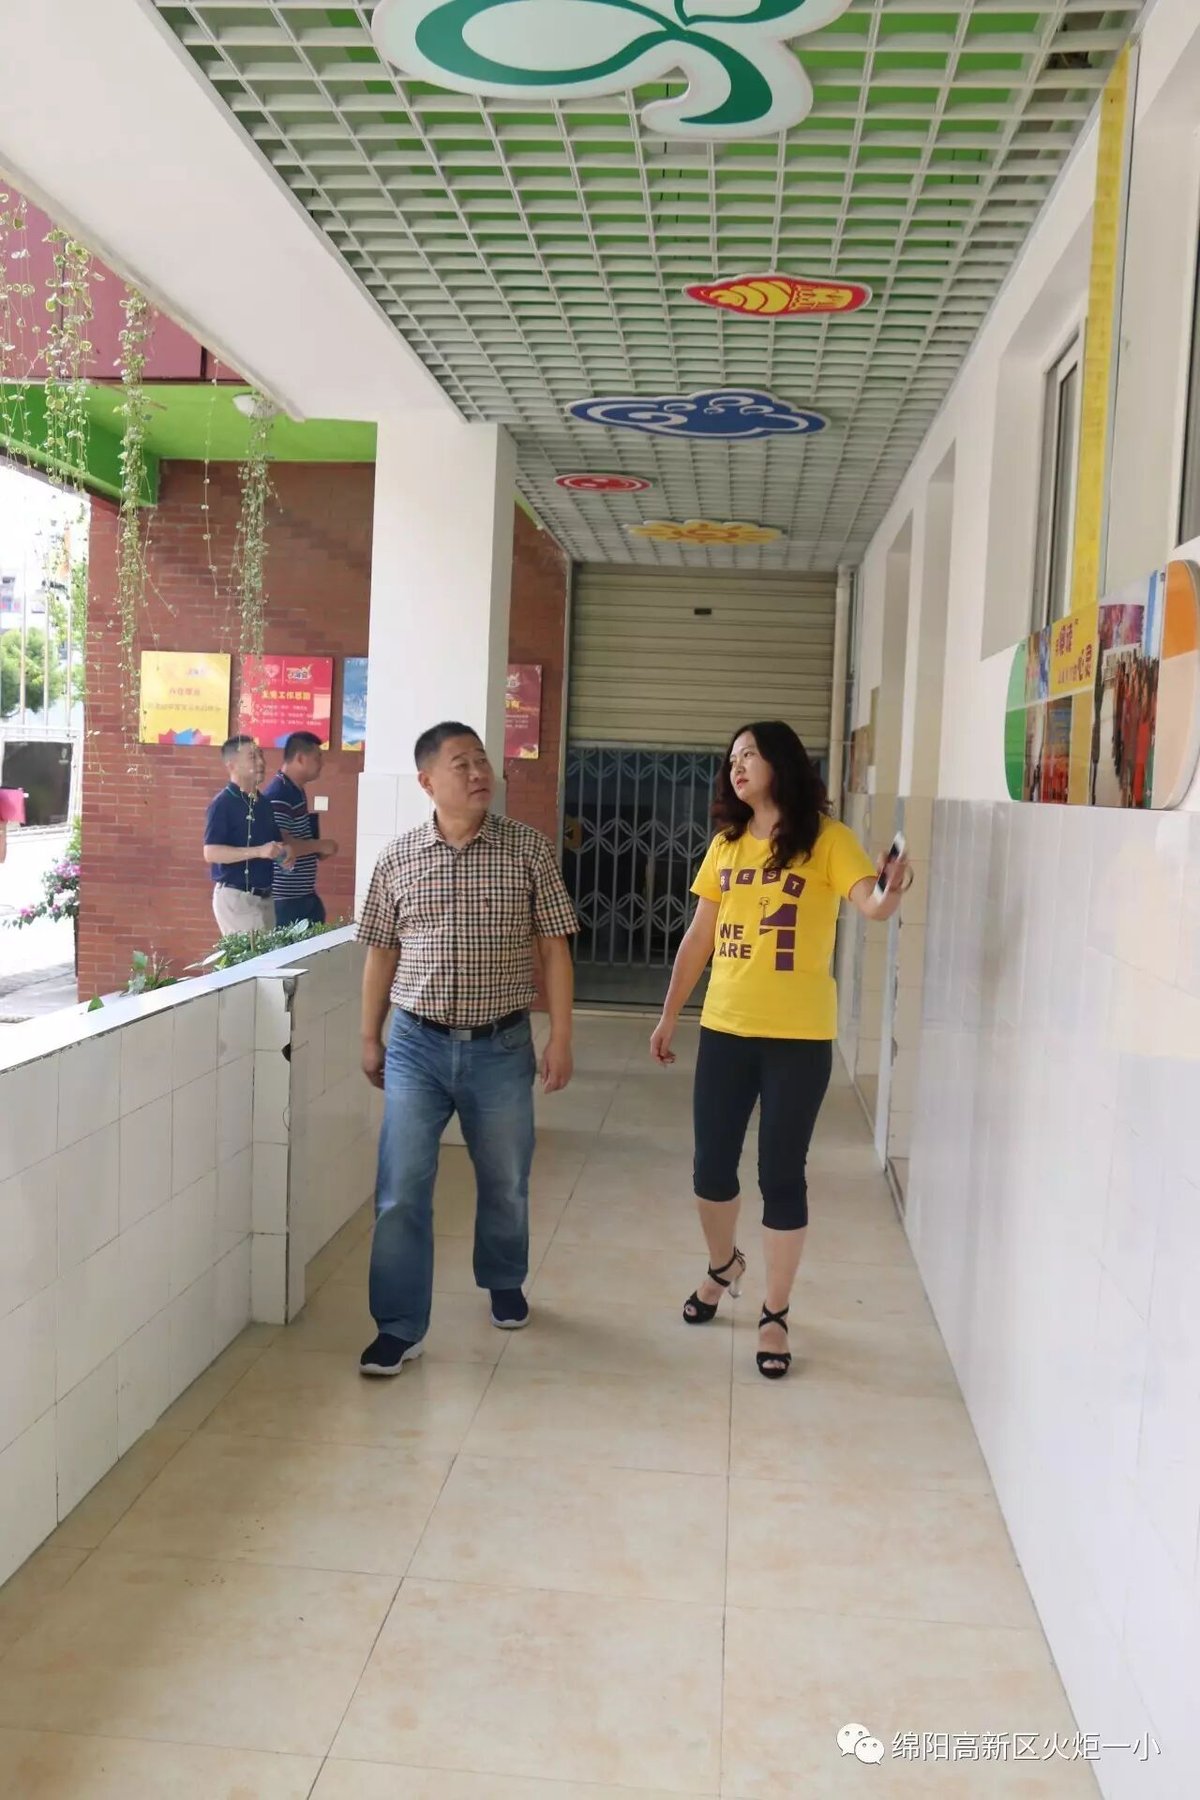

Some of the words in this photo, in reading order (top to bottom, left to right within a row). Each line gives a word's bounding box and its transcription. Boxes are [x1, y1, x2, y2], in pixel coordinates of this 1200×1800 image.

[720, 869, 801, 892] BEST
[720, 923, 744, 940] WE
[719, 942, 752, 960] ARE
